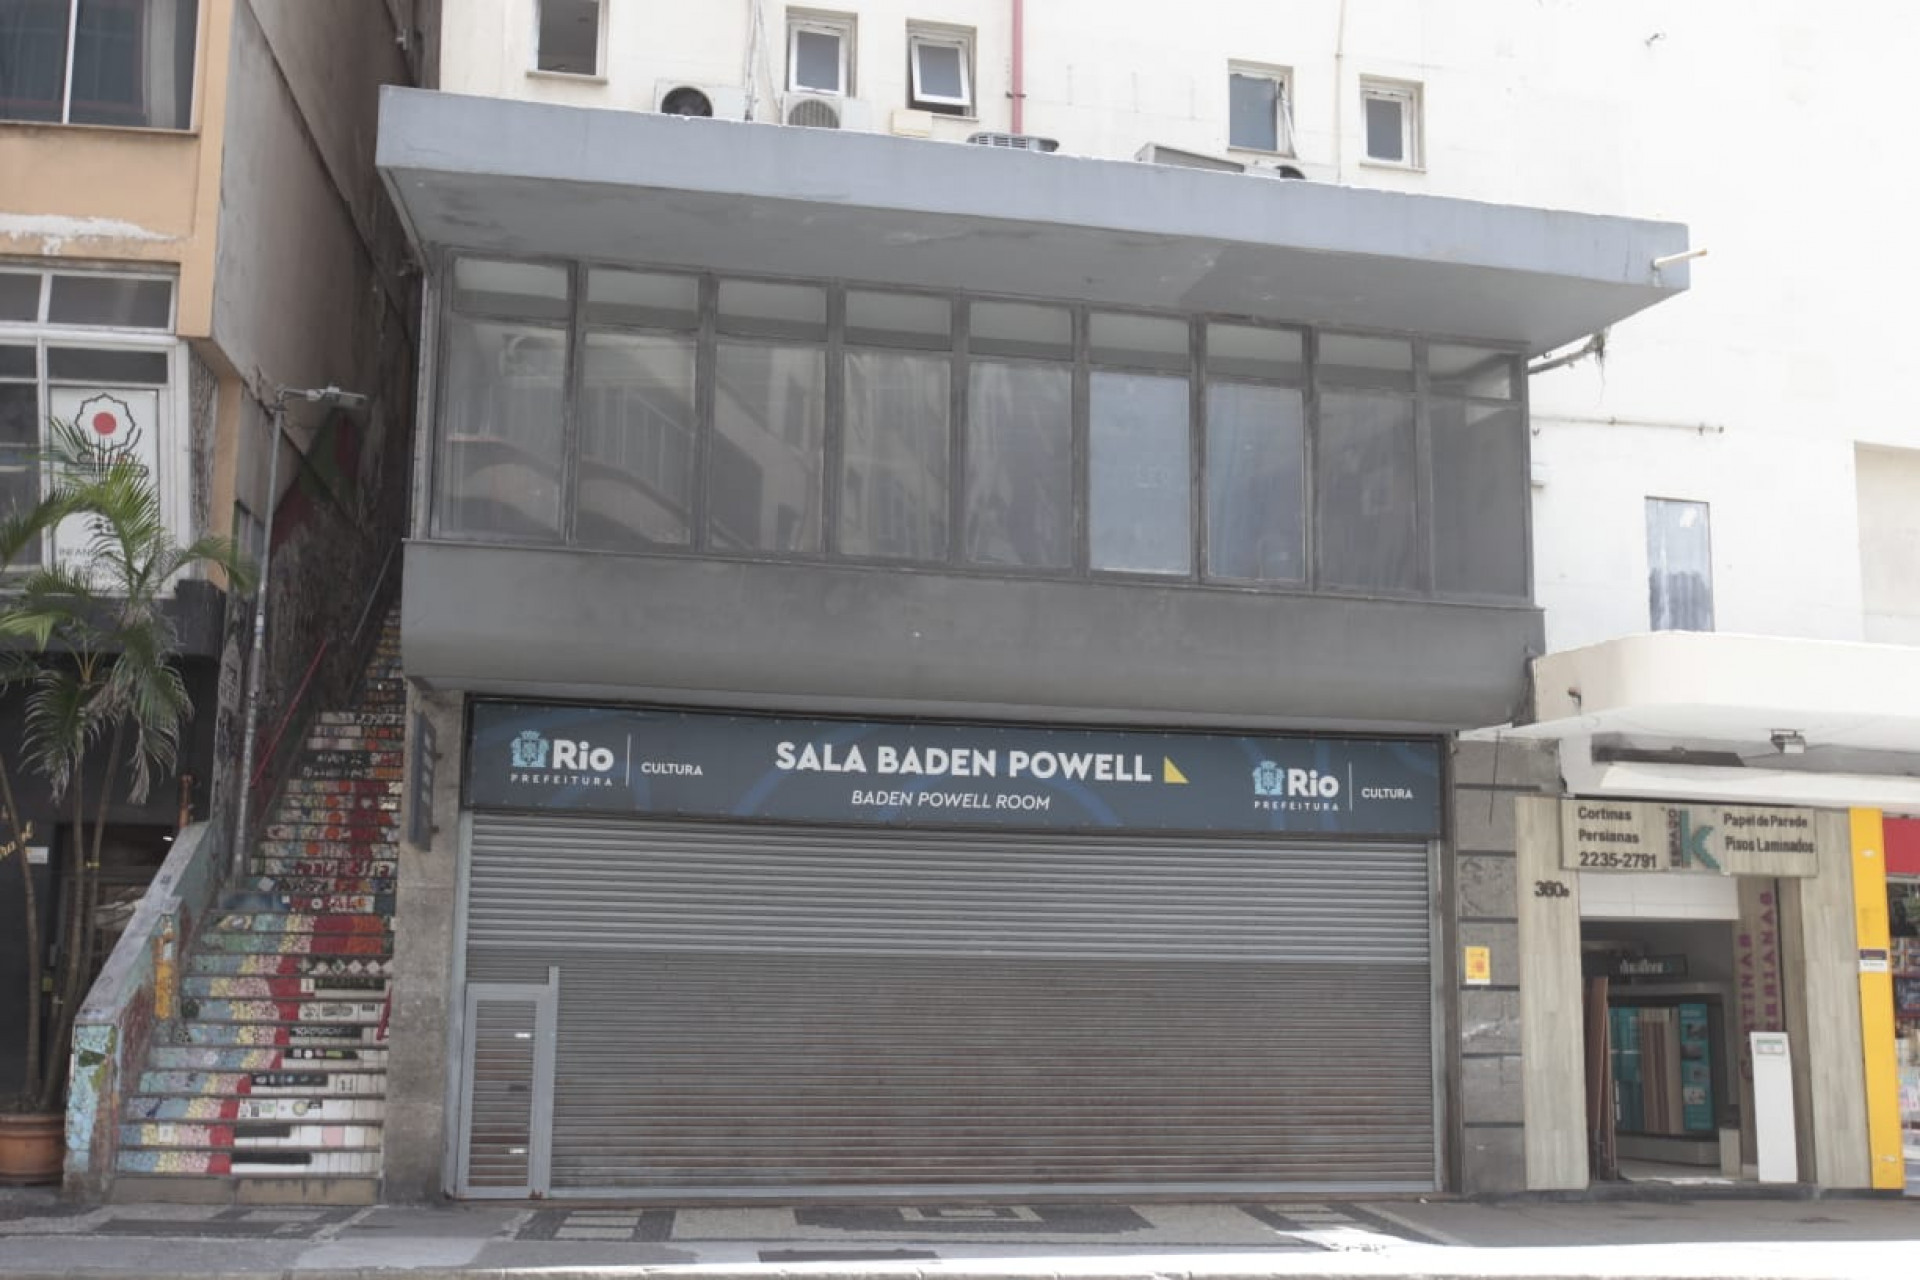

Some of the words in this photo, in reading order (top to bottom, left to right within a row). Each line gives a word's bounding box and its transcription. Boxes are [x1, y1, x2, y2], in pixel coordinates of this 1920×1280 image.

[552, 739, 614, 772] Rio
[775, 741, 867, 773] SALA
[877, 745, 996, 777] BADEN
[1009, 750, 1152, 782] POWELL
[641, 761, 703, 776] CULTURA
[510, 773, 613, 787] PREFEITURA
[1288, 768, 1339, 798] Rio
[851, 789, 913, 806] BADEN
[917, 792, 991, 808] POWELL
[996, 794, 1050, 810] ROOM
[1361, 787, 1413, 799] CULTURA
[1254, 800, 1339, 812] PREFEITURA
[1578, 806, 1632, 820] Cortinas
[1723, 813, 1755, 828] Papel
[1757, 815, 1769, 827] de
[1770, 815, 1808, 828] Parede
[1578, 827, 1640, 844] Persianas
[1724, 835, 1755, 852] Pisos
[1756, 837, 1814, 854] Laminados
[1579, 851, 1657, 869] 2235-2791
